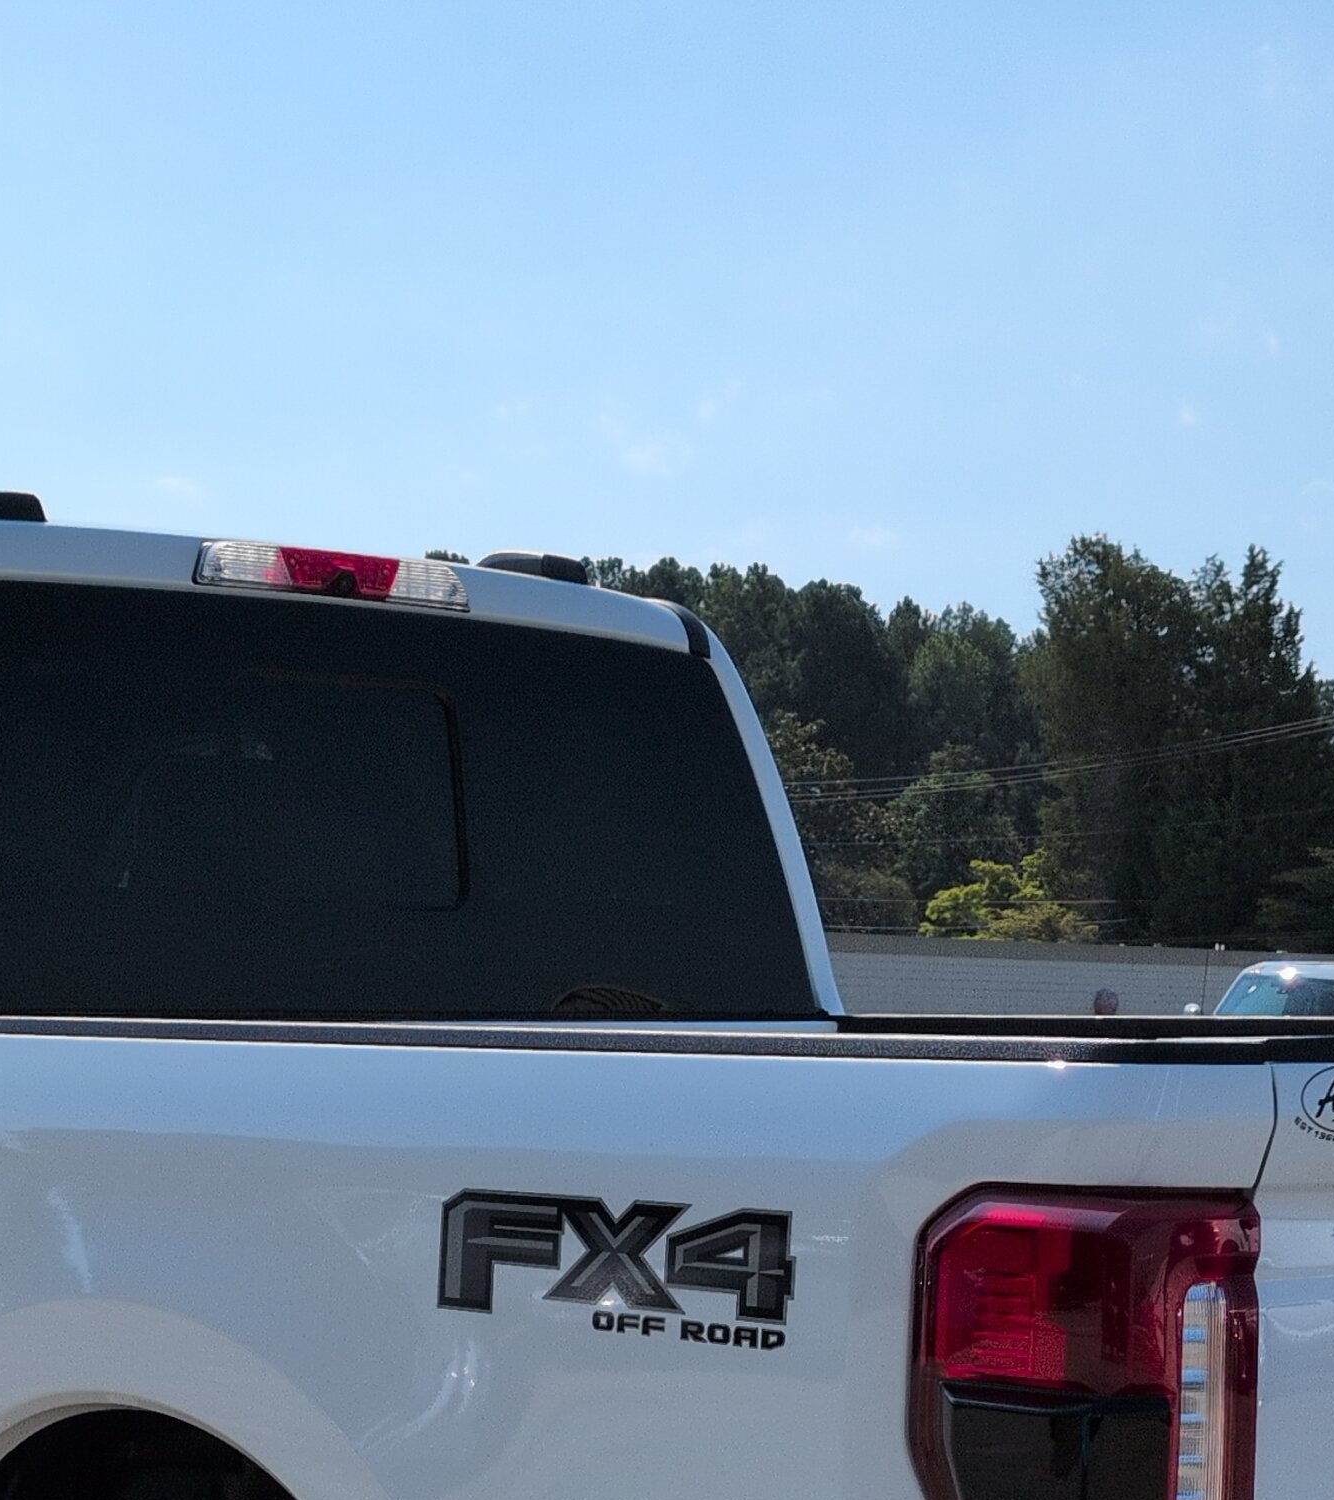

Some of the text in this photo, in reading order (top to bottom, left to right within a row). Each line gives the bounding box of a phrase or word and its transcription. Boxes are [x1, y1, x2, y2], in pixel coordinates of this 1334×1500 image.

[436, 1187, 797, 1326] FX4
[591, 1309, 787, 1351] OFF ROAD
